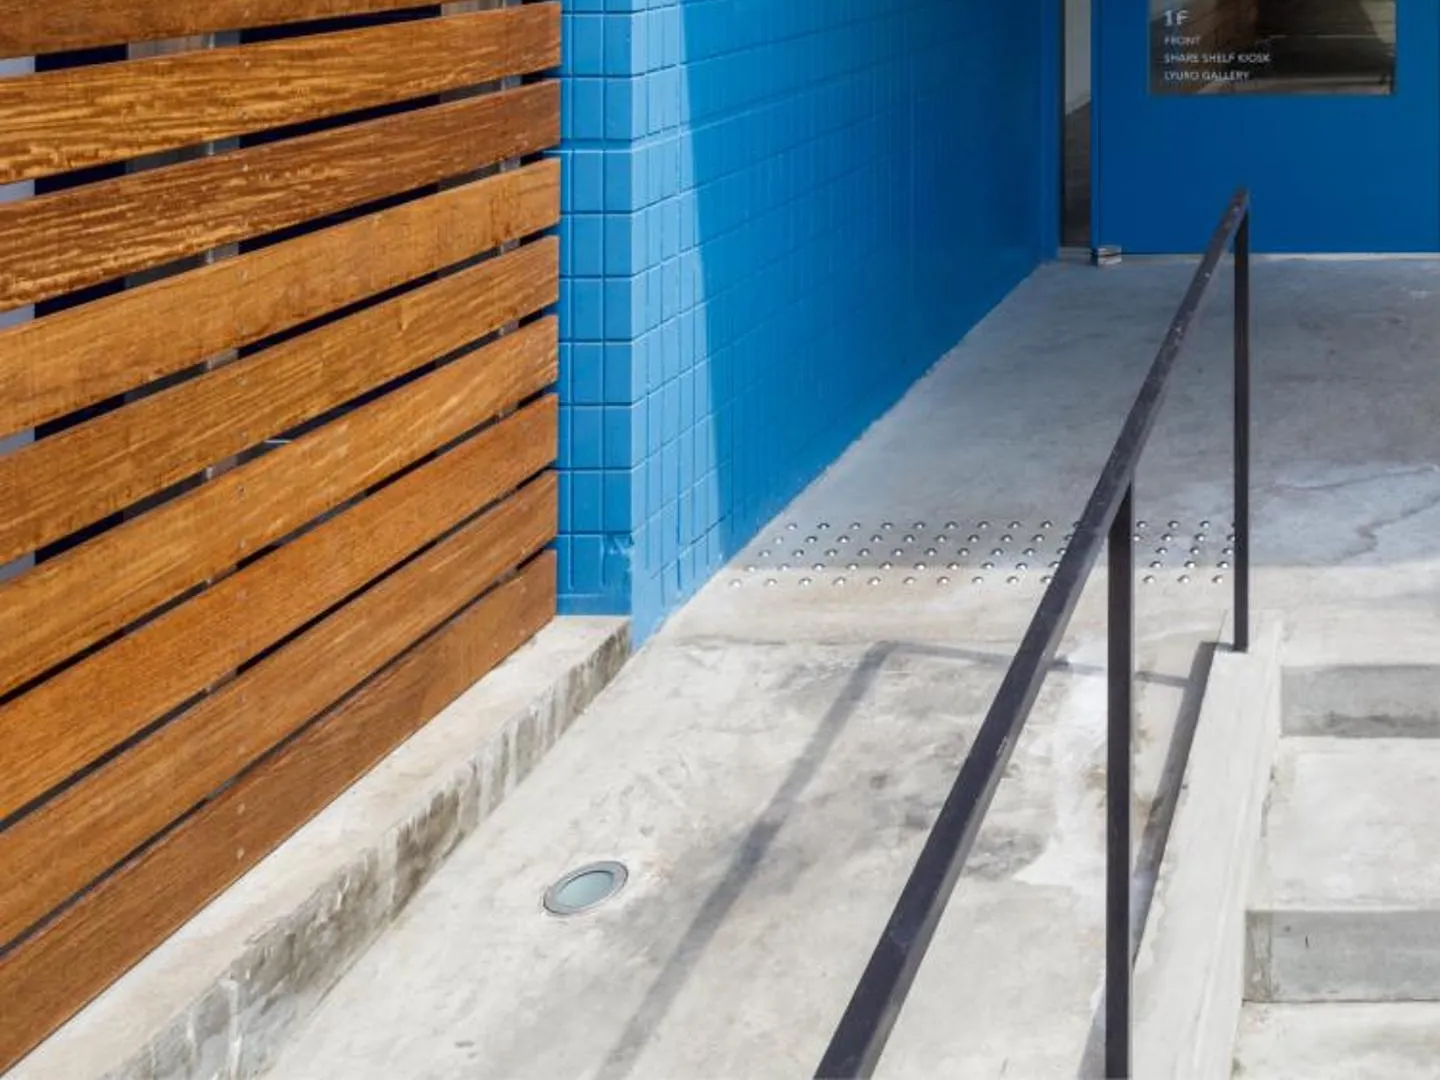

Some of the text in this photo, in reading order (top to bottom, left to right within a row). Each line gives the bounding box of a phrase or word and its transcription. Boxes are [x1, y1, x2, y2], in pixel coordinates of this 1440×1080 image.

[1164, 9, 1189, 26] 1F
[1164, 35, 1200, 45] FRONT
[1202, 52, 1235, 63] SHELF
[1238, 52, 1270, 63] KIOSK
[1202, 70, 1250, 81] GALLERY
